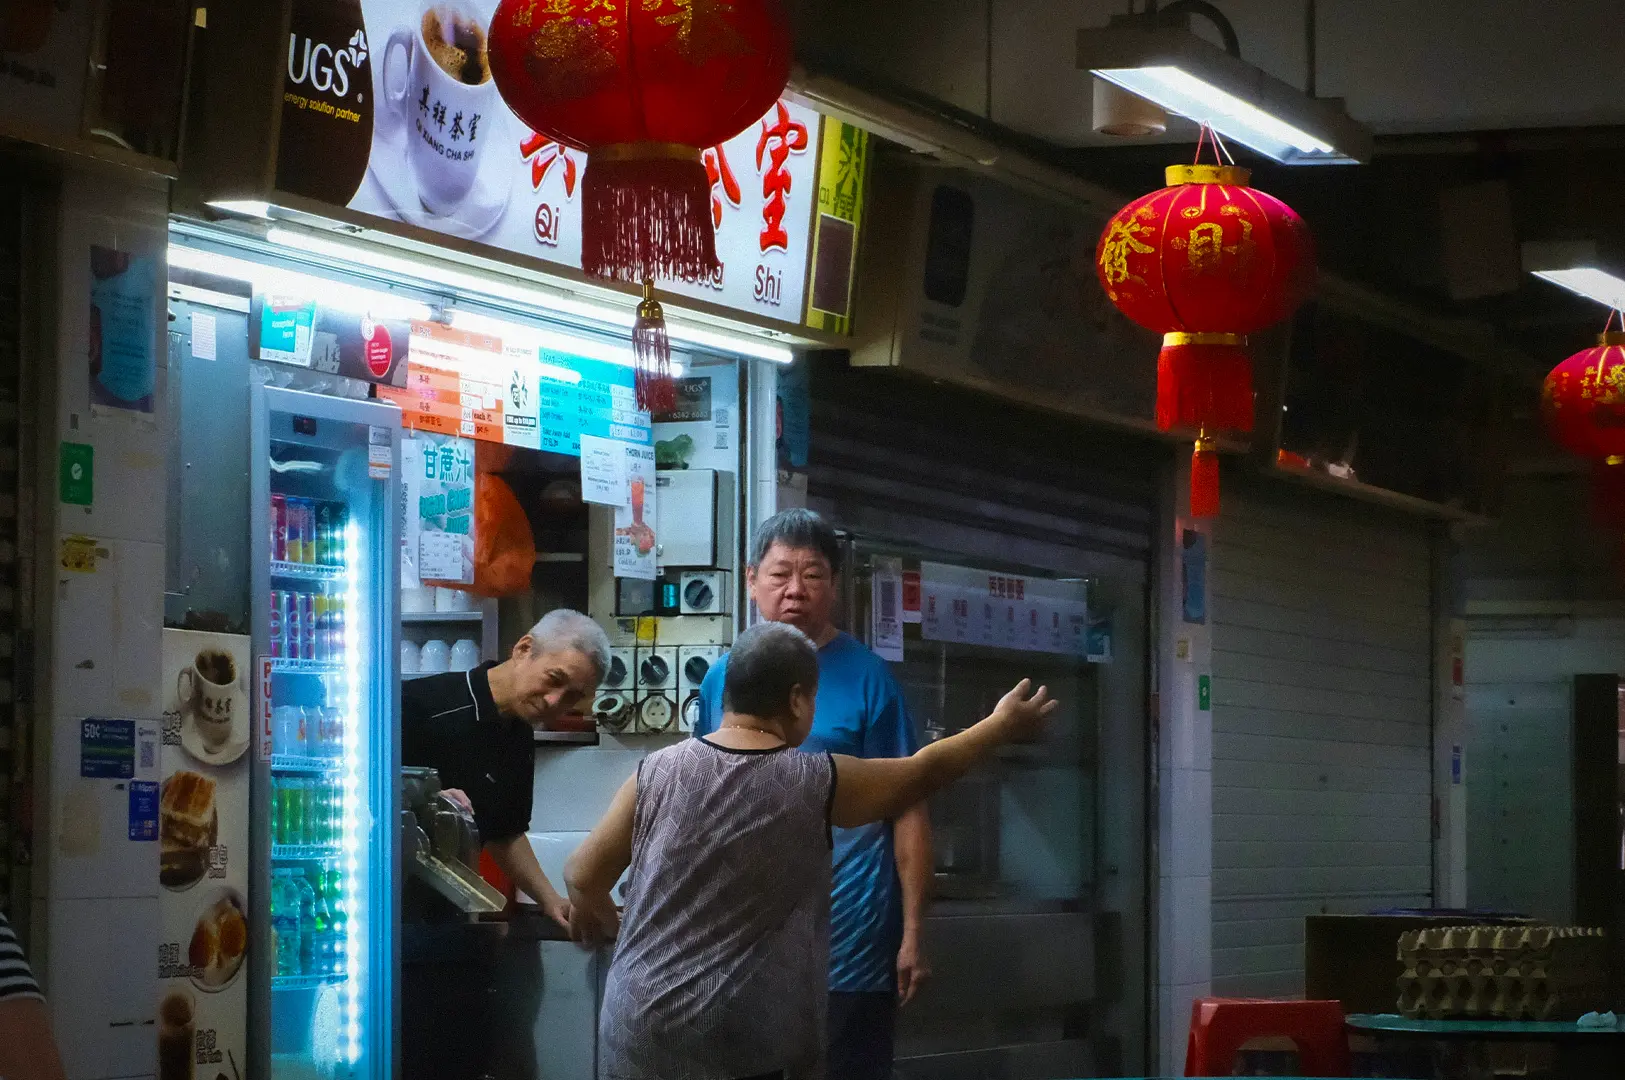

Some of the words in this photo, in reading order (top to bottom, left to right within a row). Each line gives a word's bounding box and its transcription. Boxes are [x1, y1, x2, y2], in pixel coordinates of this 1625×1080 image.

[288, 33, 350, 97] UGS
[284, 92, 308, 109] energy
[309, 99, 335, 115] solution
[335, 107, 361, 122] partner
[422, 128, 445, 155] XIANG
[446, 148, 461, 161] CHA
[534, 203, 560, 245] Qi
[755, 264, 782, 304] Shi
[684, 384, 704, 399] UGS
[423, 445, 471, 483] 甘蔗汁
[263, 661, 272, 736] PULL
